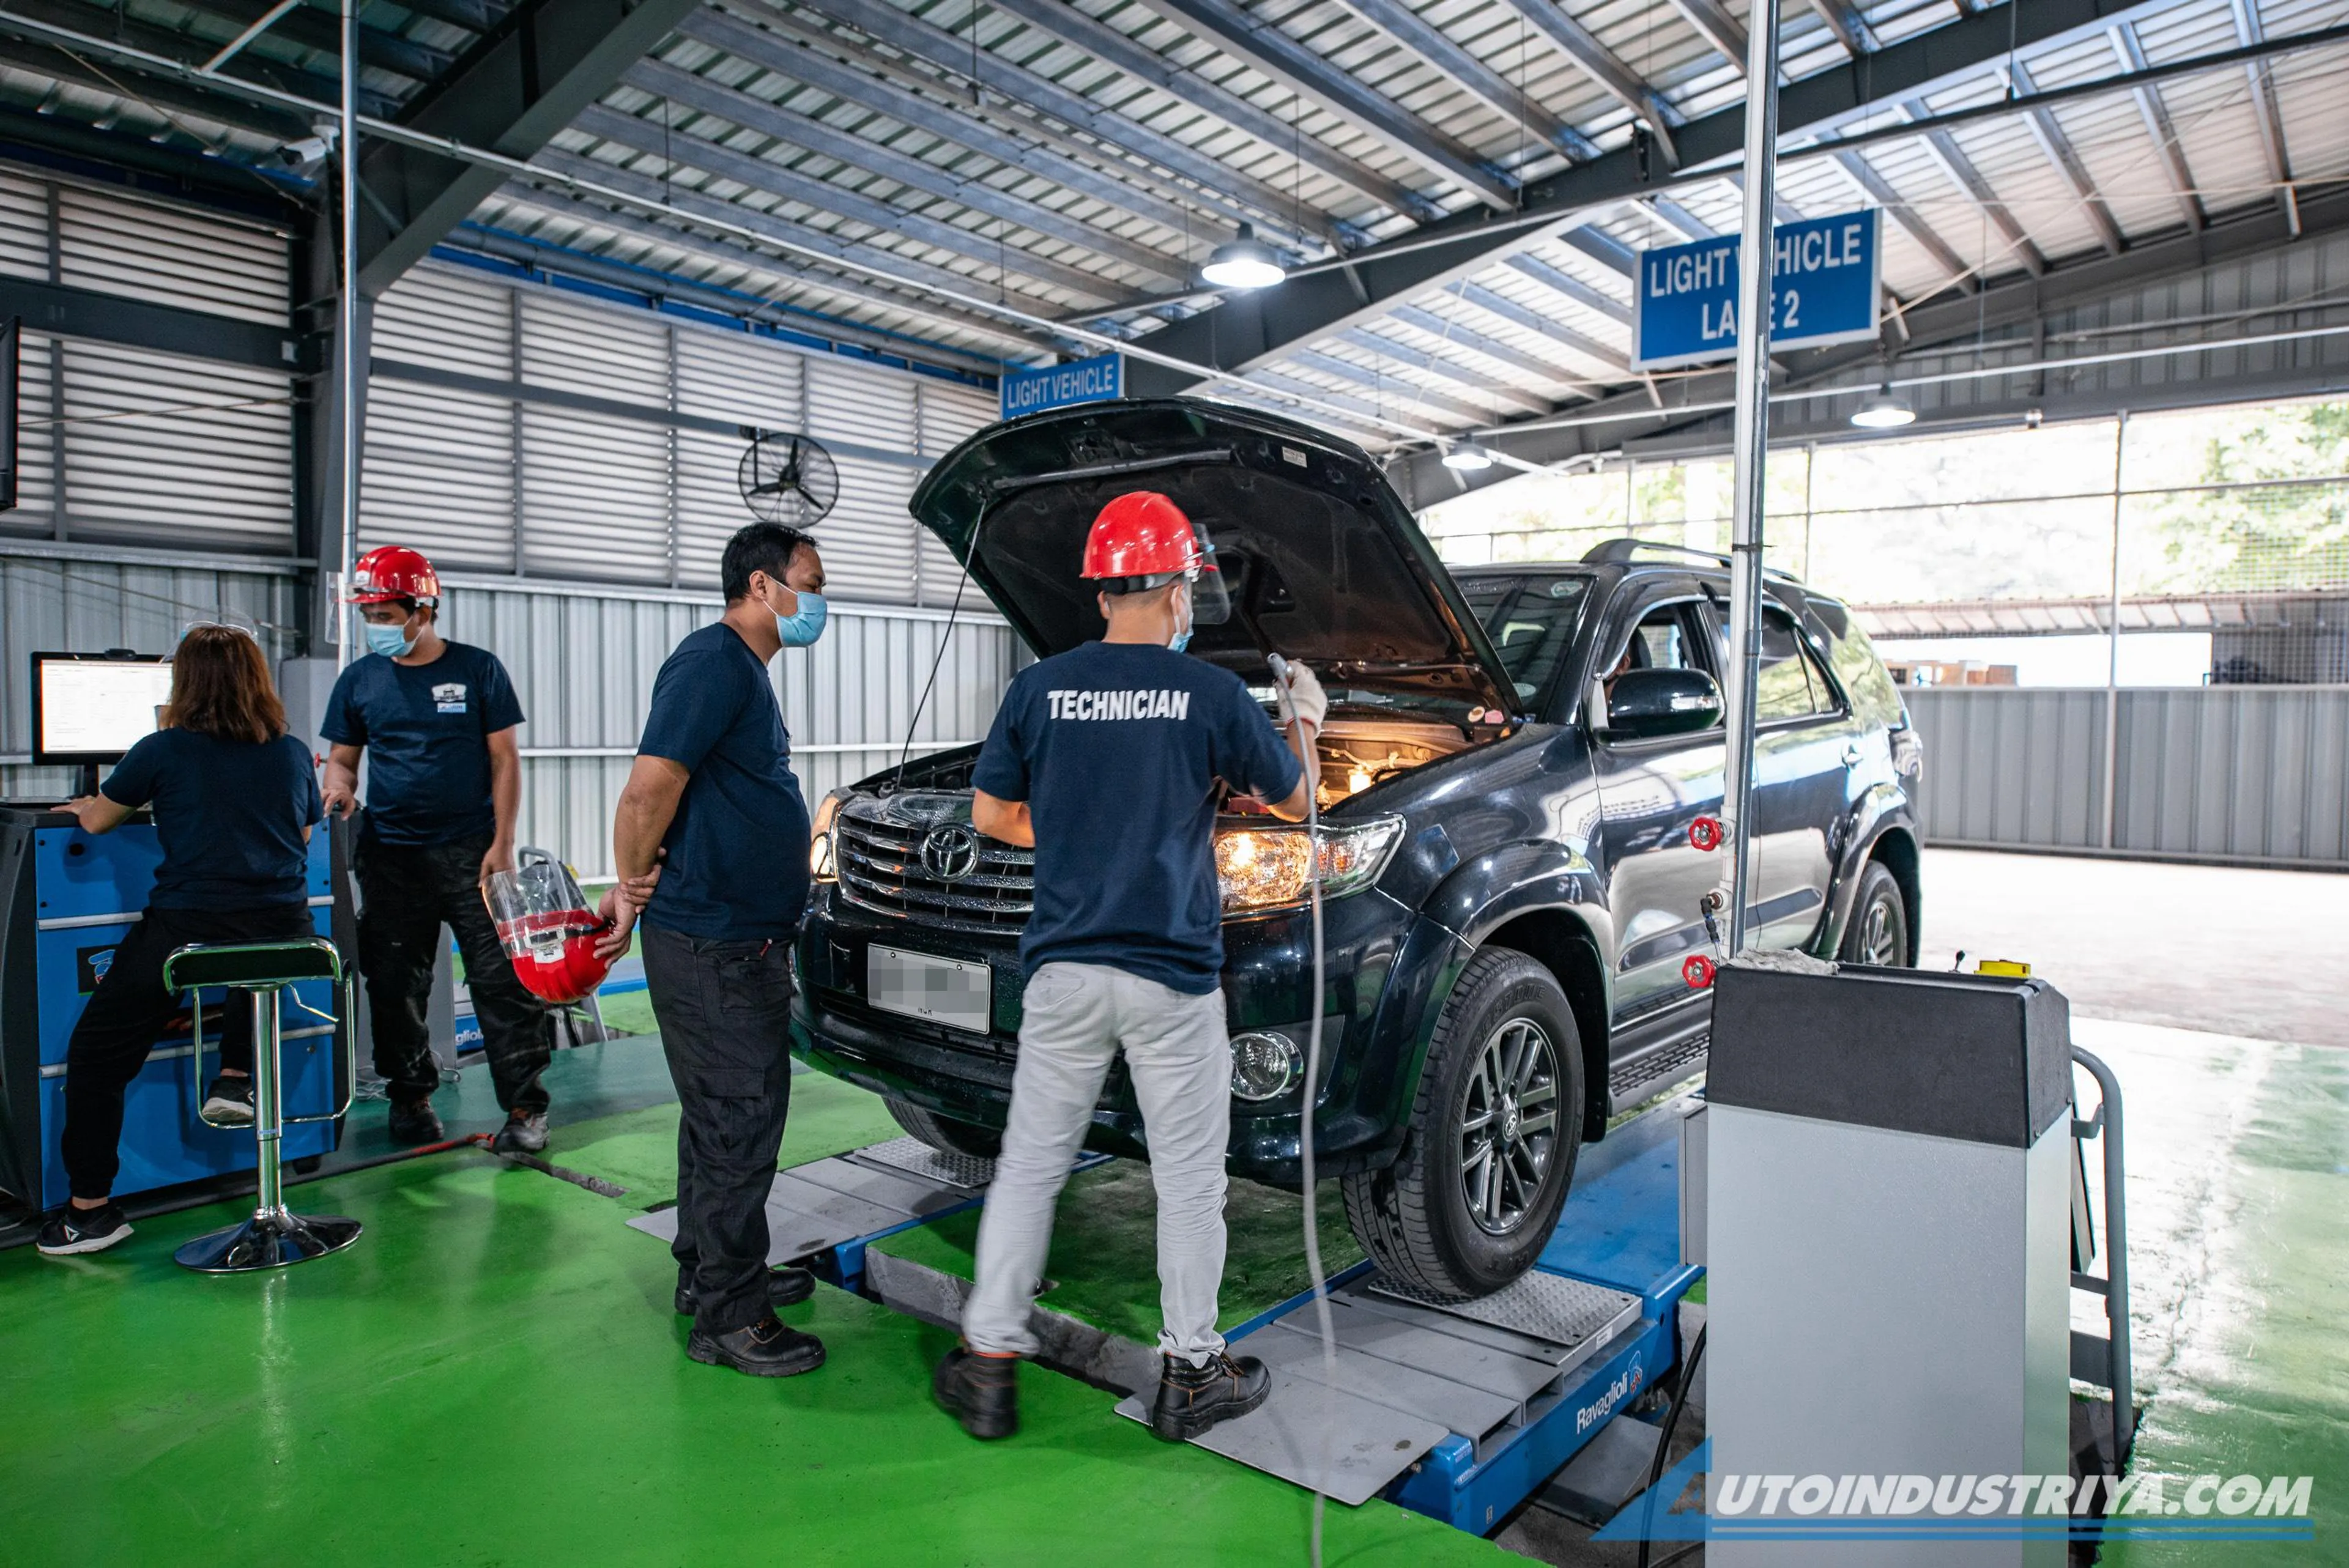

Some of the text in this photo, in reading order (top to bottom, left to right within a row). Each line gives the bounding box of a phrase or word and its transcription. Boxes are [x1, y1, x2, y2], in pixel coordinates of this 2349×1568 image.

[1650, 224, 1861, 297] LIGHT HICLE
[1702, 289, 1800, 340] LA 2
[1008, 364, 1113, 409] LIGHT VEHICLE
[1047, 689, 1190, 721] TECHNICIAN
[1577, 1371, 1628, 1435] Ravaglioli
